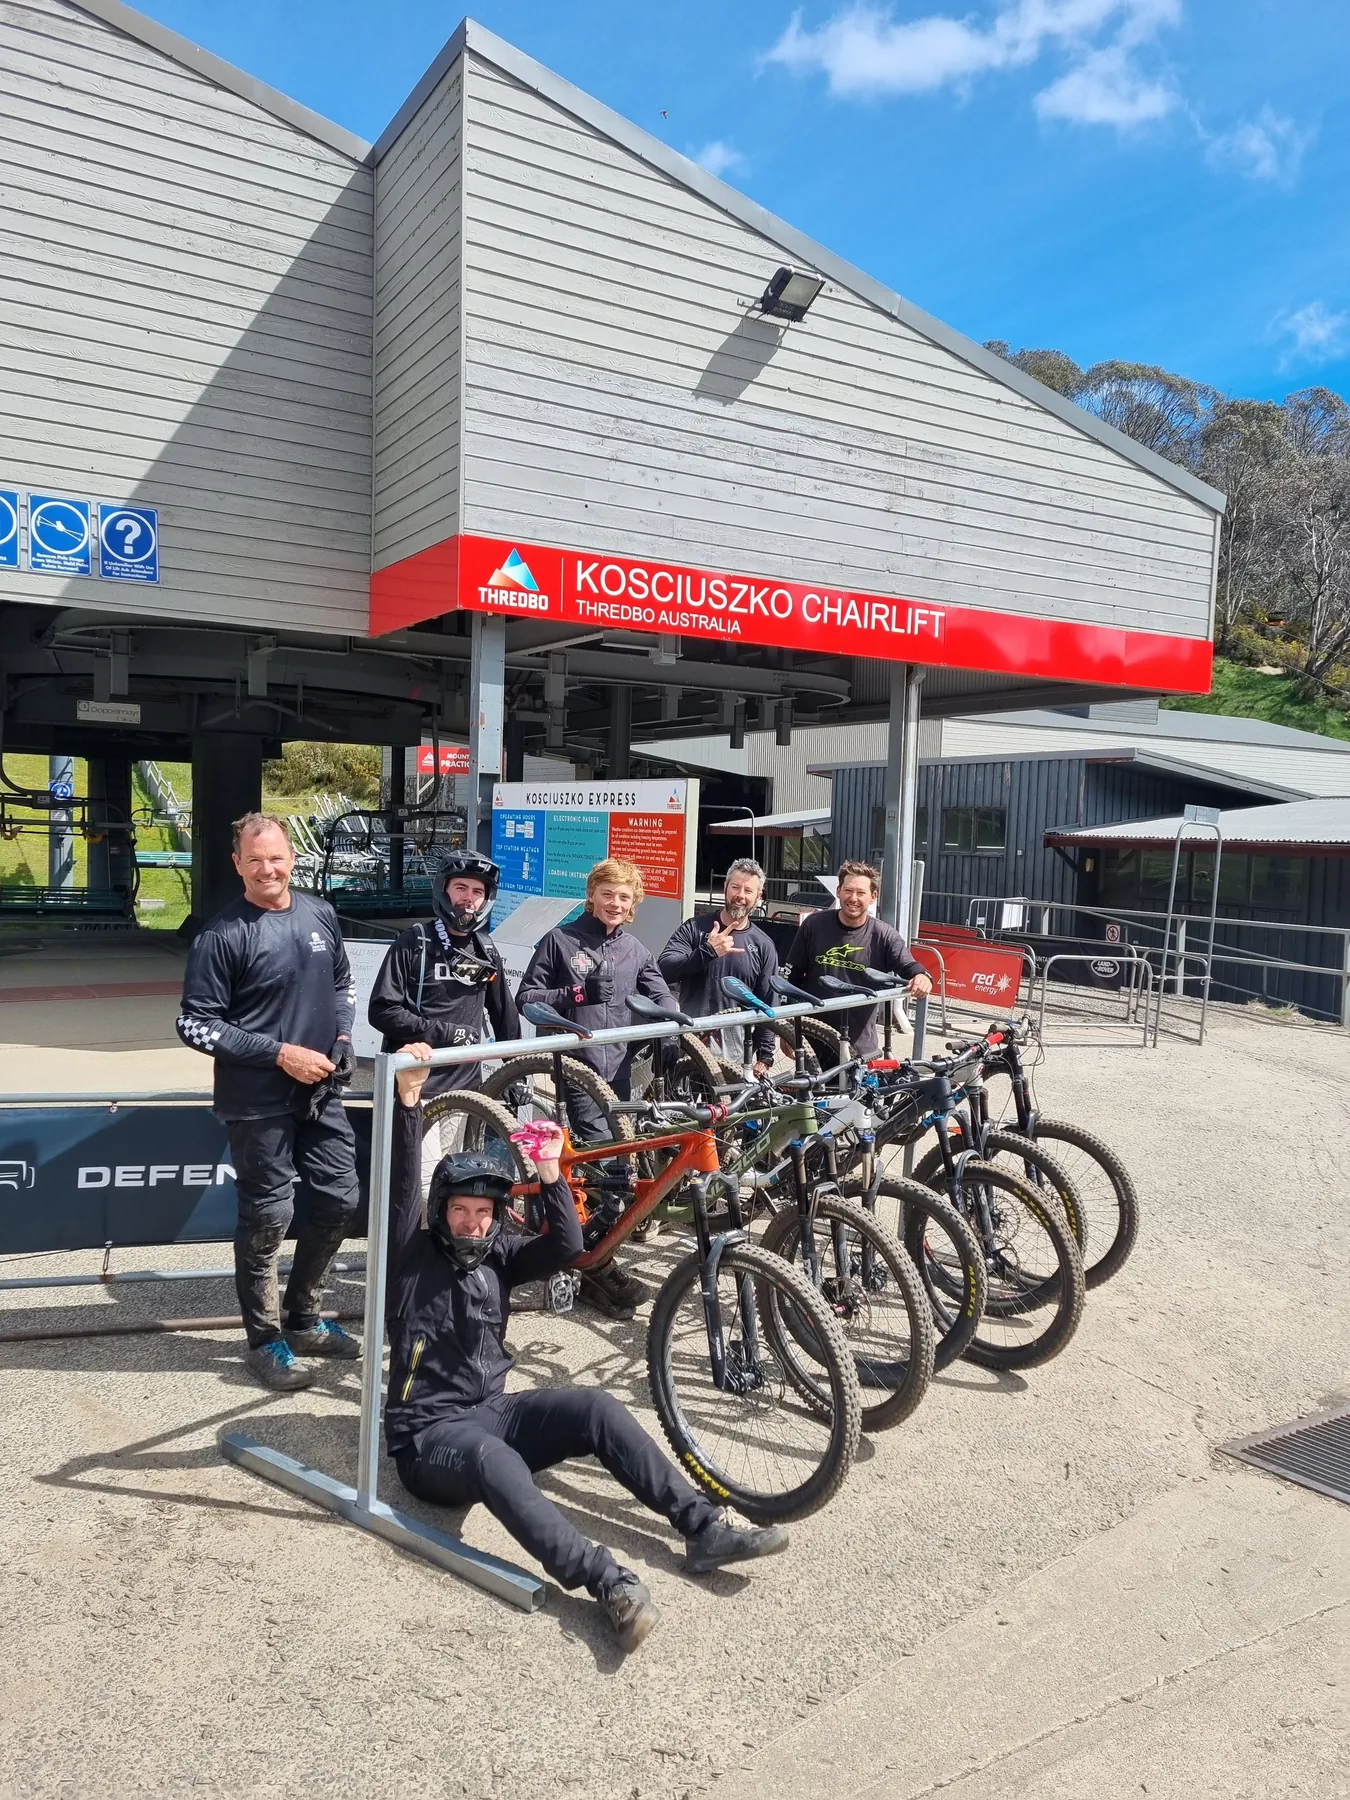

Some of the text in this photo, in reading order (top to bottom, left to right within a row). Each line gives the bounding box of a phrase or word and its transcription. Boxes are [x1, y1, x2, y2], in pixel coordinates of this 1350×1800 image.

[477, 586, 549, 611] THREDBO
[576, 560, 945, 638] KOSCIUSZKO CHAIRLIFT
[576, 600, 742, 635] THREDBO AUSTRALIA
[526, 792, 636, 806] KOSCIUSZKO EXPRESS
[553, 815, 581, 823] ELECTRONIC
[628, 817, 663, 828] WARNING
[548, 868, 568, 877] LOADING
[525, 885, 542, 893] STATION
[434, 918, 452, 951] 100%
[971, 972, 996, 986] red
[974, 984, 998, 996] energy
[1062, 1190, 1078, 1236] MAXXIS
[967, 1264, 976, 1318] MAXXIS
[683, 1452, 731, 1498] MAXXIS
